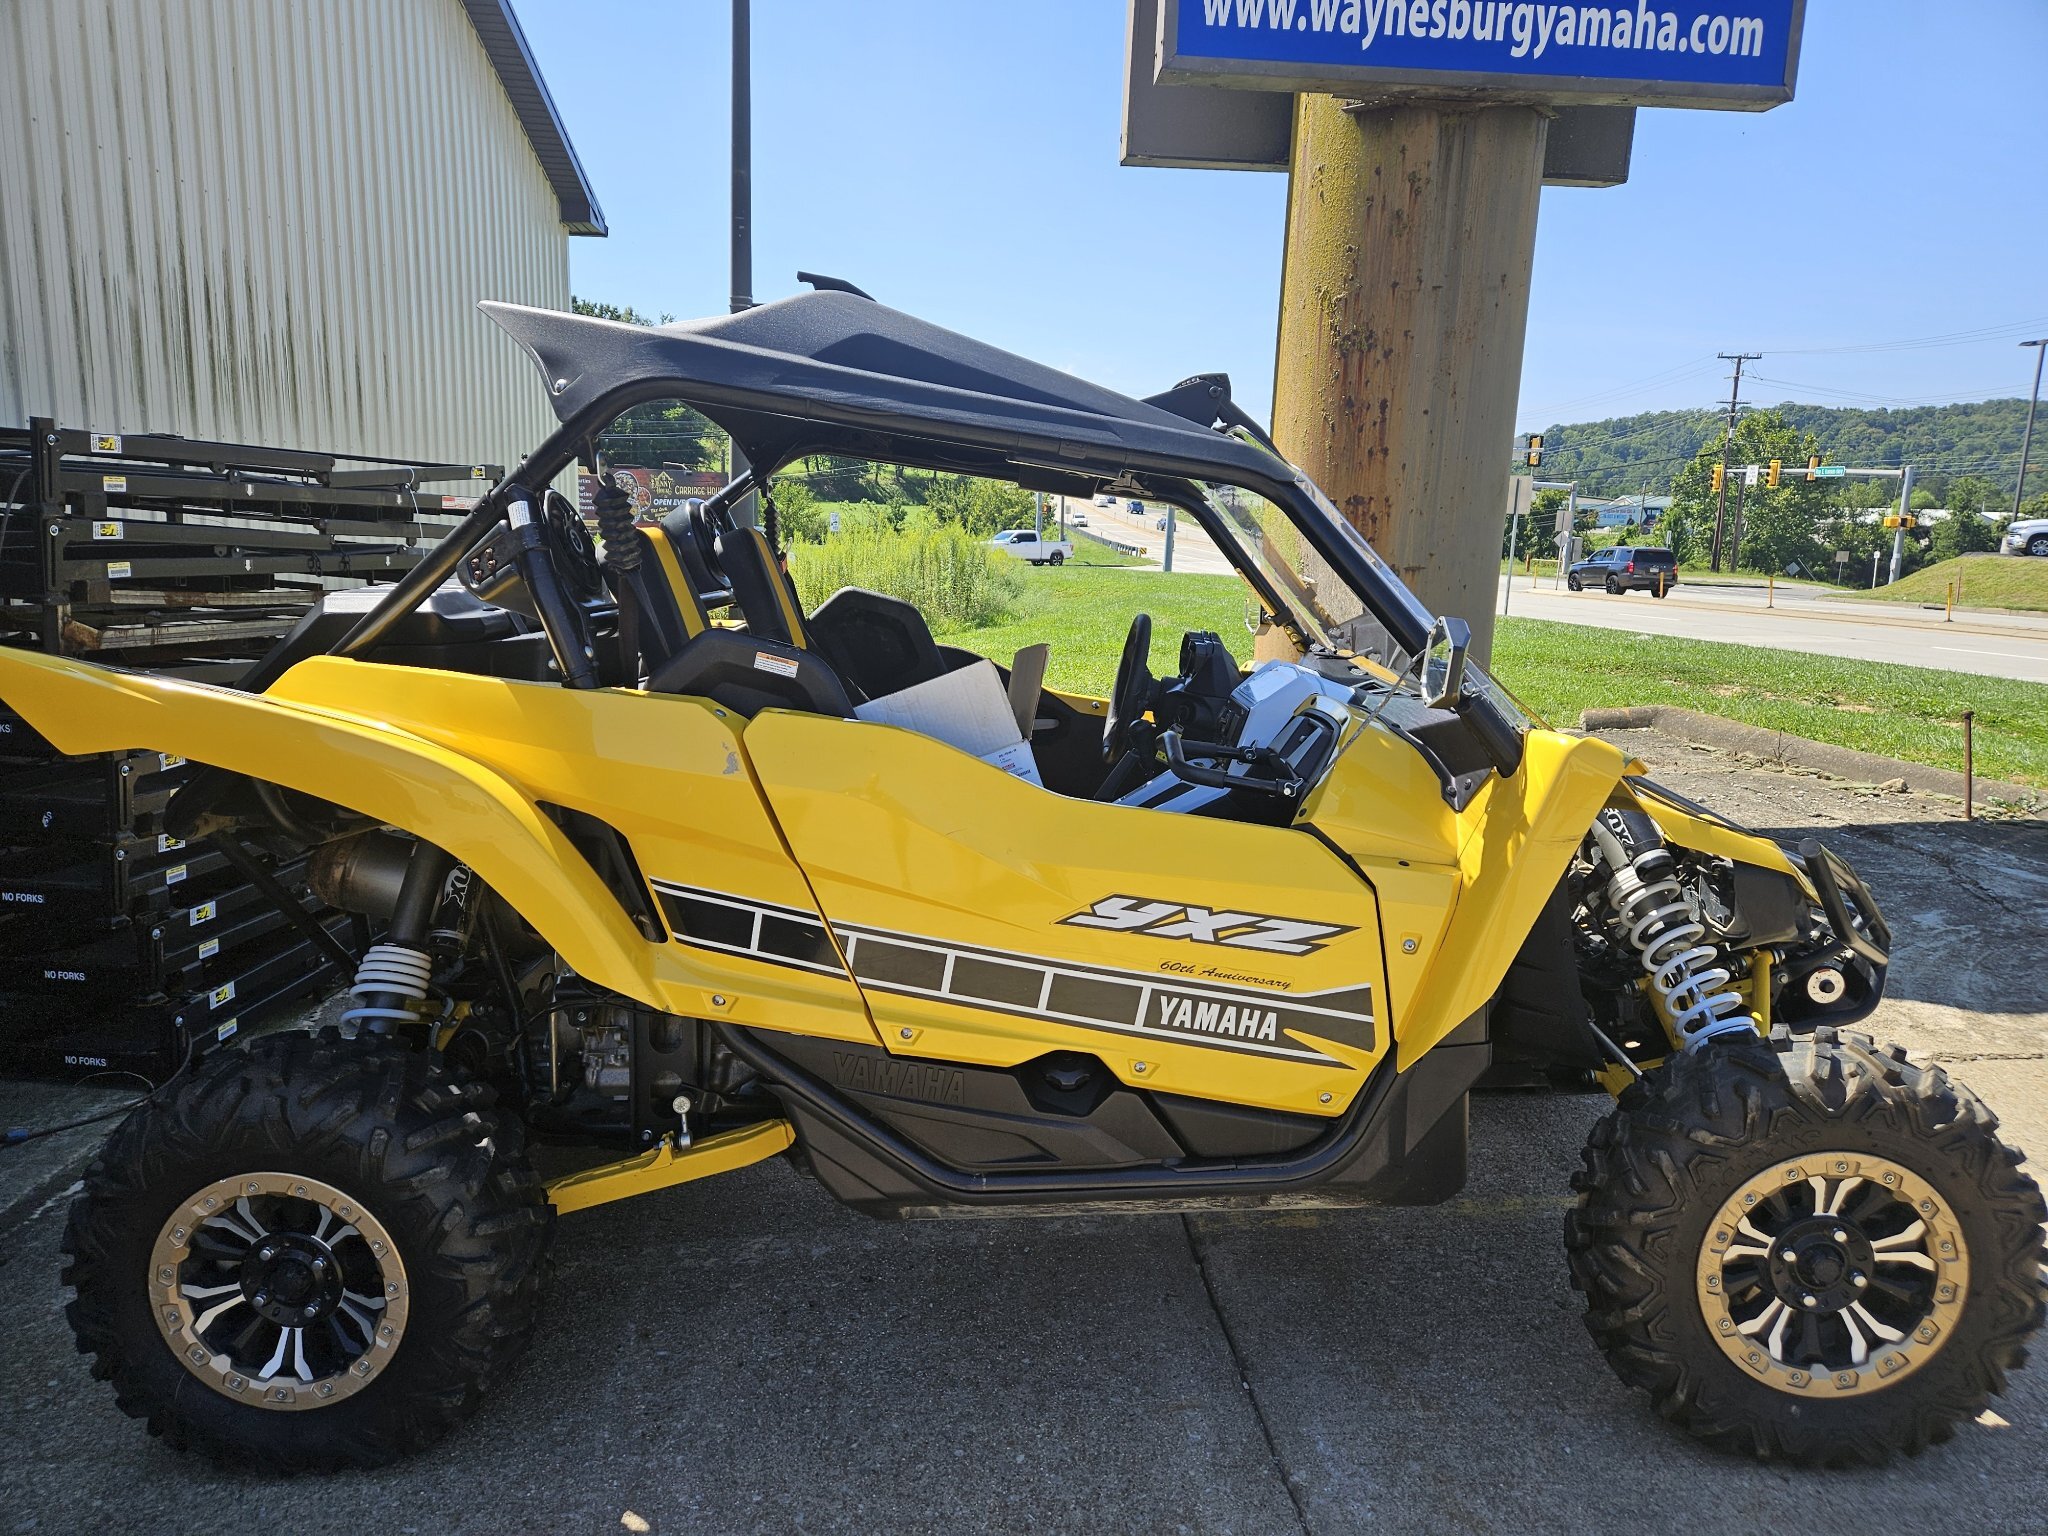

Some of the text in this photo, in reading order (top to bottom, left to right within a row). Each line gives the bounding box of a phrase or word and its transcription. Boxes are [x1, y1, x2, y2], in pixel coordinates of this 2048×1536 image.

[1203, 0, 1764, 59] www.waynesburgyamaha.com
[653, 498, 672, 506] OPEN
[2, 892, 44, 904] NO FORKS
[1055, 893, 1362, 957] YXZ
[44, 970, 86, 981] NO FORKS
[1159, 960, 1293, 990] 60th Anniversary
[1159, 995, 1278, 1042] YAMAHA
[64, 1055, 107, 1067] NO FORKS
[832, 1051, 966, 1104] YAMAHA
